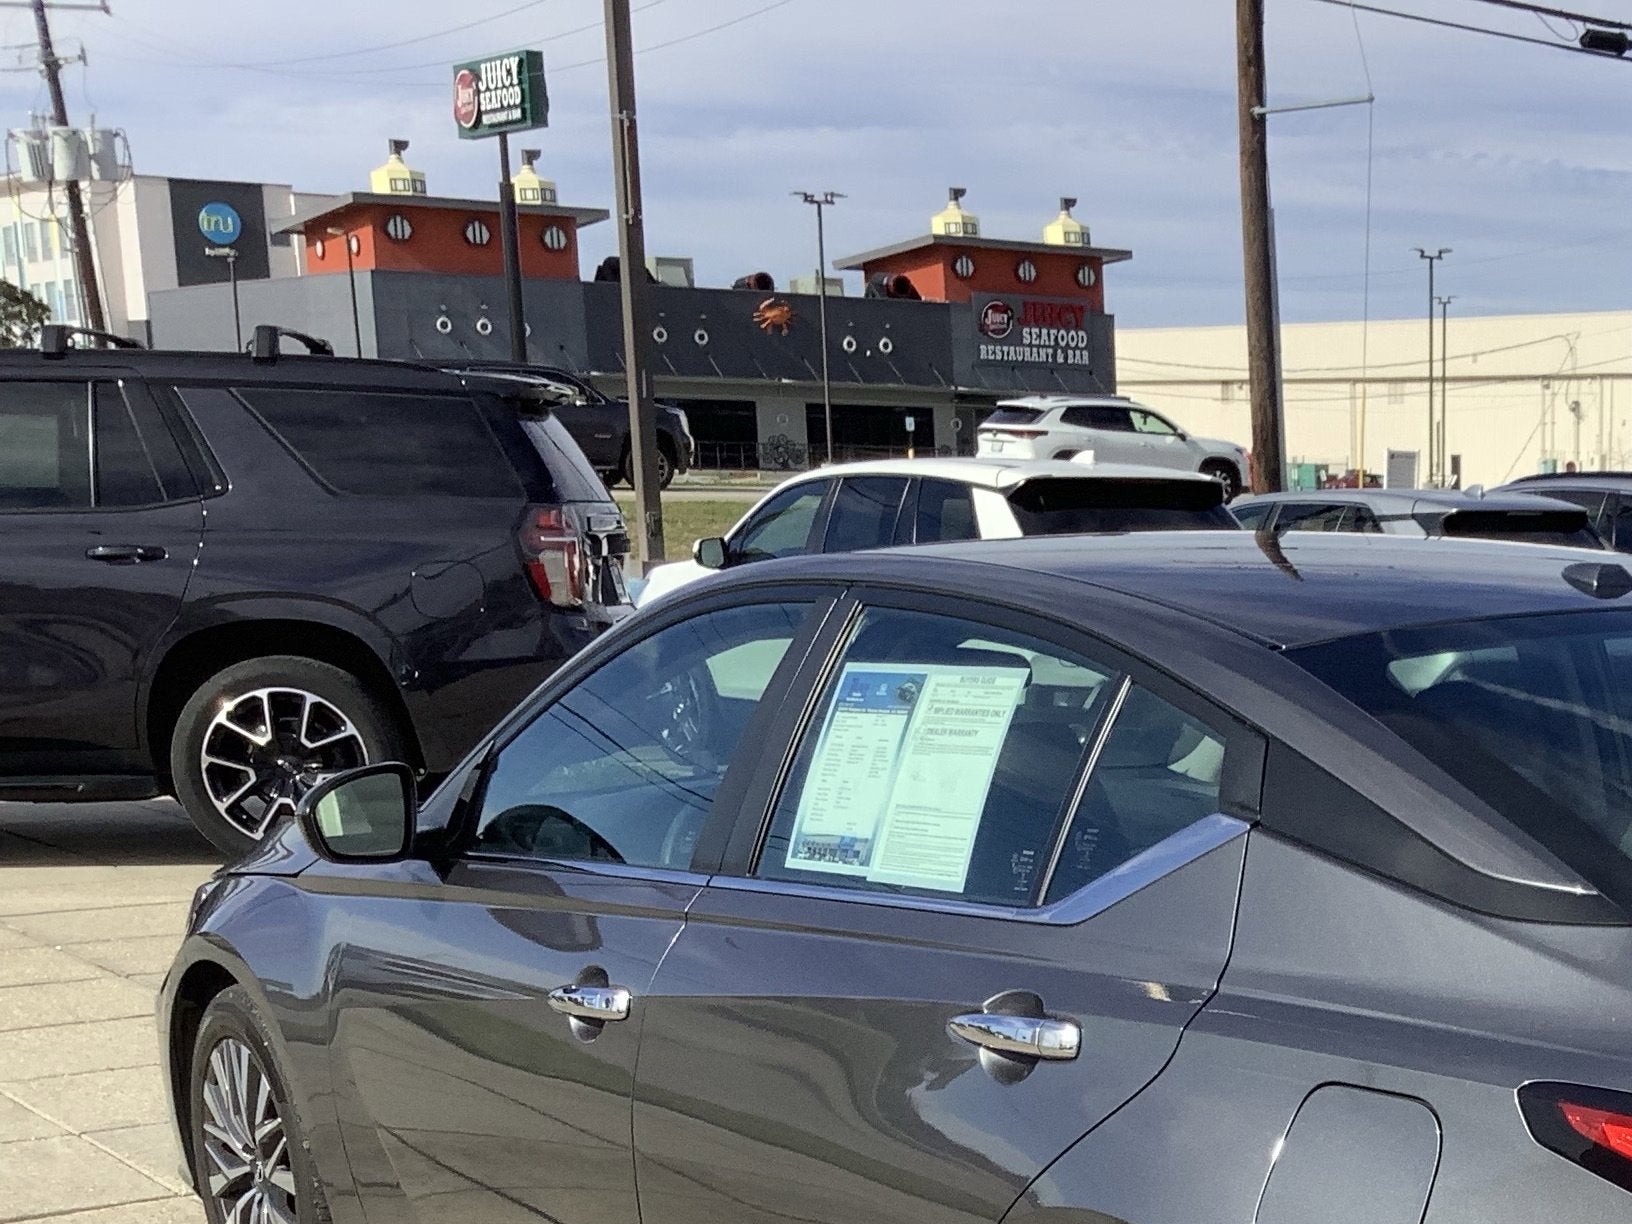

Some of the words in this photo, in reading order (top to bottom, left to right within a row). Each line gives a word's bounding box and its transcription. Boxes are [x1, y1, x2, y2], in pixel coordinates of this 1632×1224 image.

[478, 56, 519, 91] JUICY
[480, 86, 521, 111] SEAFOOD
[1018, 301, 1086, 329] JUICY
[1022, 327, 1087, 348] SEAFOOD
[980, 345, 1053, 363] RESTAURANT
[1056, 349, 1064, 363] &
[1067, 350, 1089, 365] BAR
